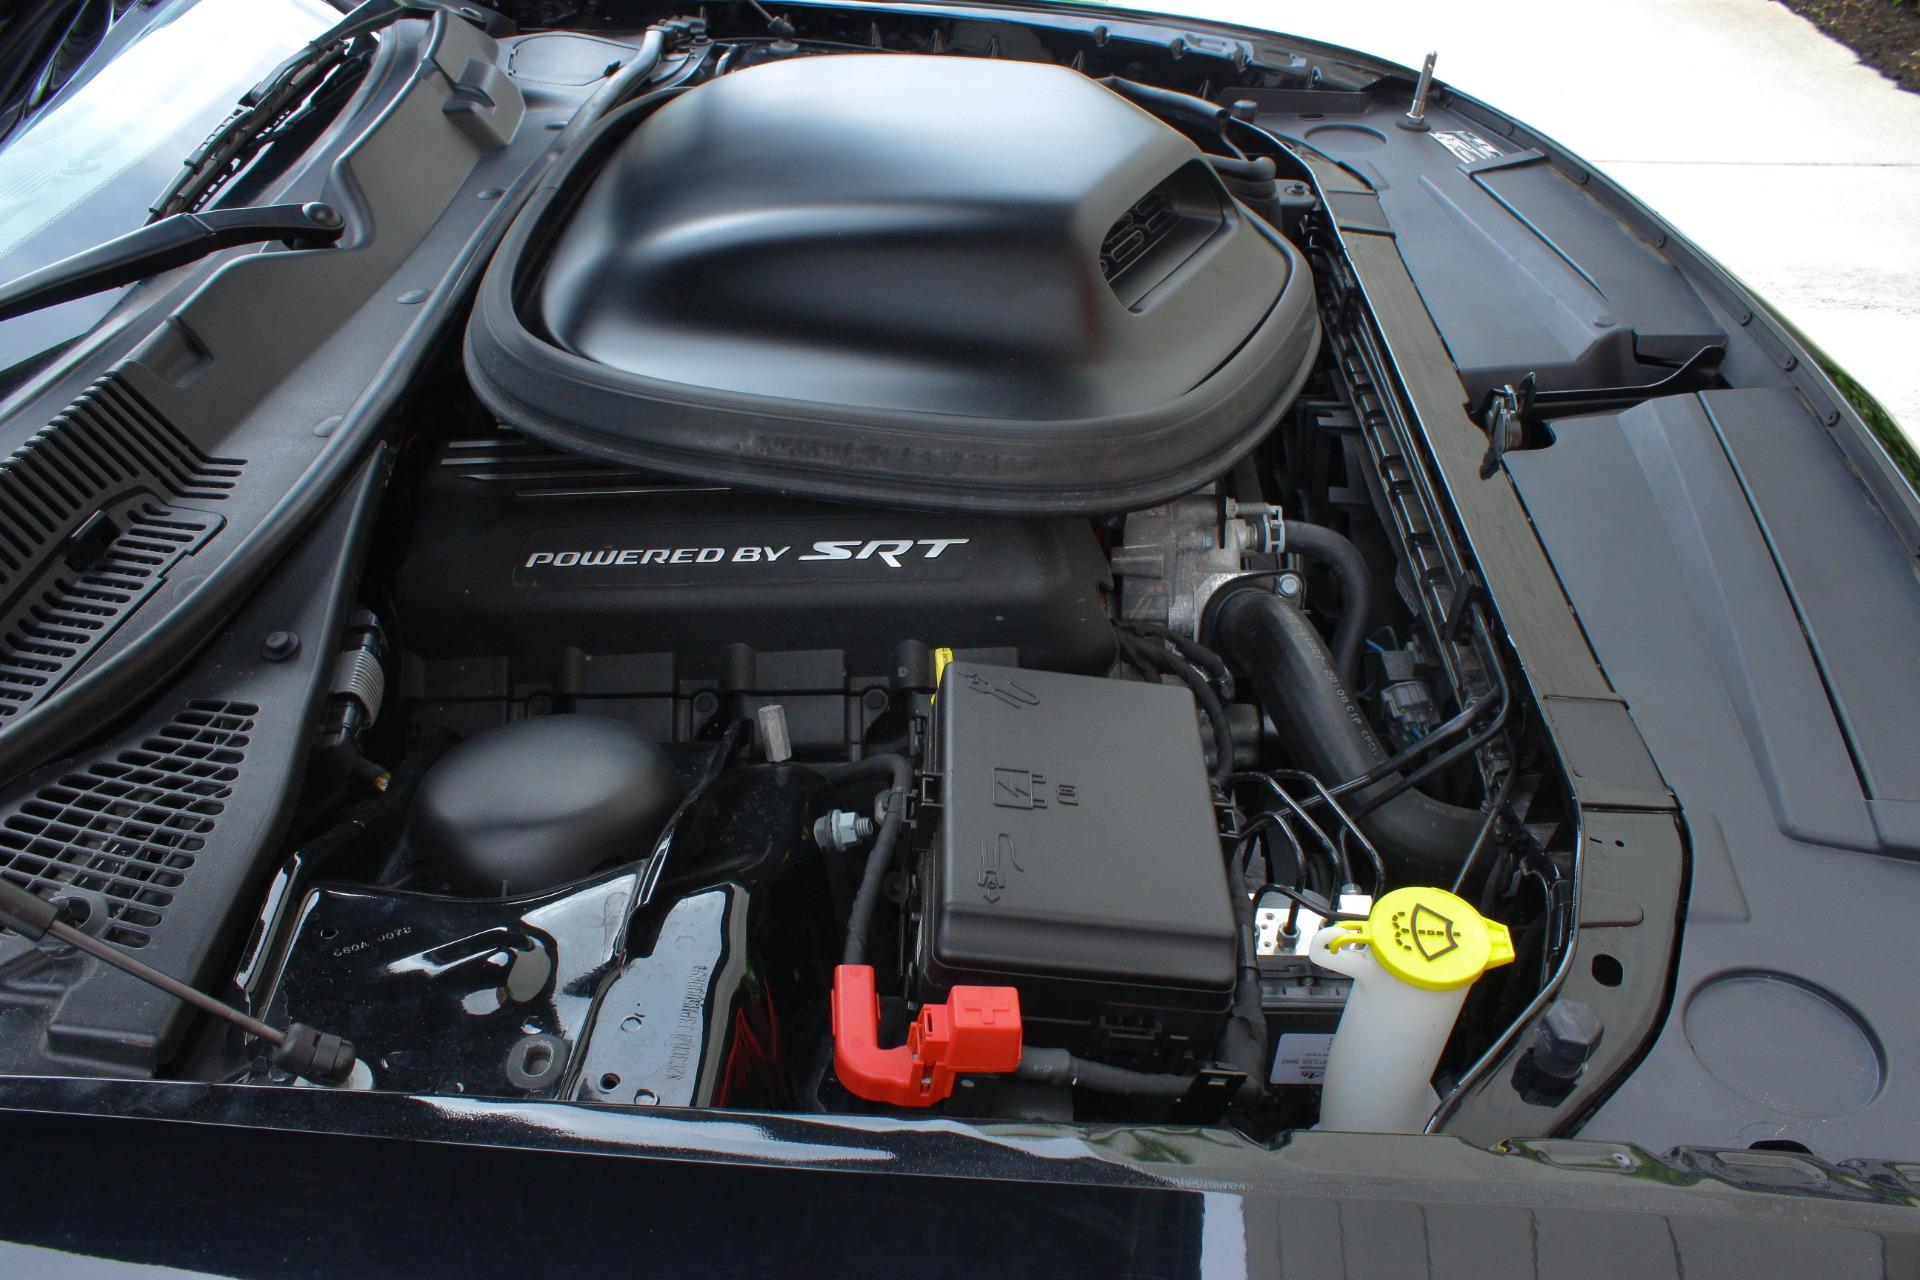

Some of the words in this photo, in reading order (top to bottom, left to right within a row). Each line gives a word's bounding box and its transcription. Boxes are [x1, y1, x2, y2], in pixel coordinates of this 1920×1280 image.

[525, 547, 726, 568] POWERED
[732, 545, 791, 562] BY
[798, 538, 970, 568] SRT
